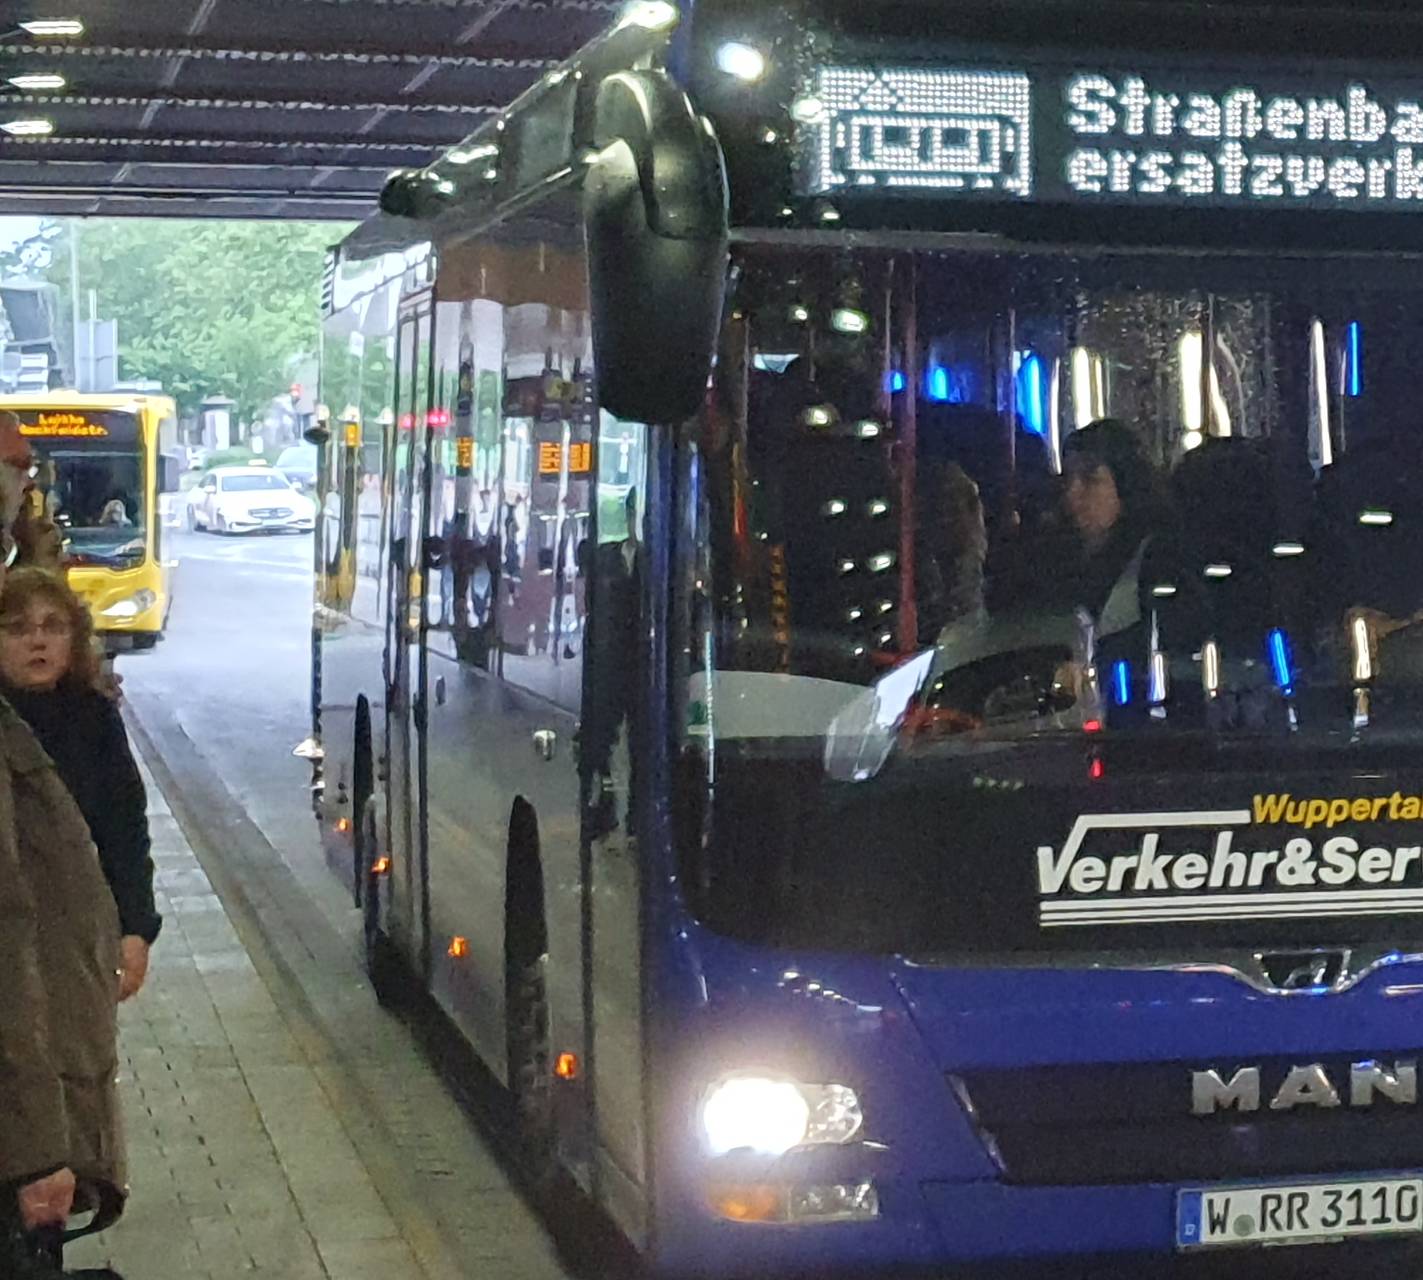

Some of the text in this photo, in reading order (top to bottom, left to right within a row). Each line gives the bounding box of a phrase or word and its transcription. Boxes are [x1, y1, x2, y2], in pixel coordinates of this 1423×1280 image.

[1191, 1060, 1418, 1114] MAN
[1207, 1197, 1231, 1236] W
[1259, 1191, 1310, 1233] RR
[1320, 1184, 1418, 1228] 3110
